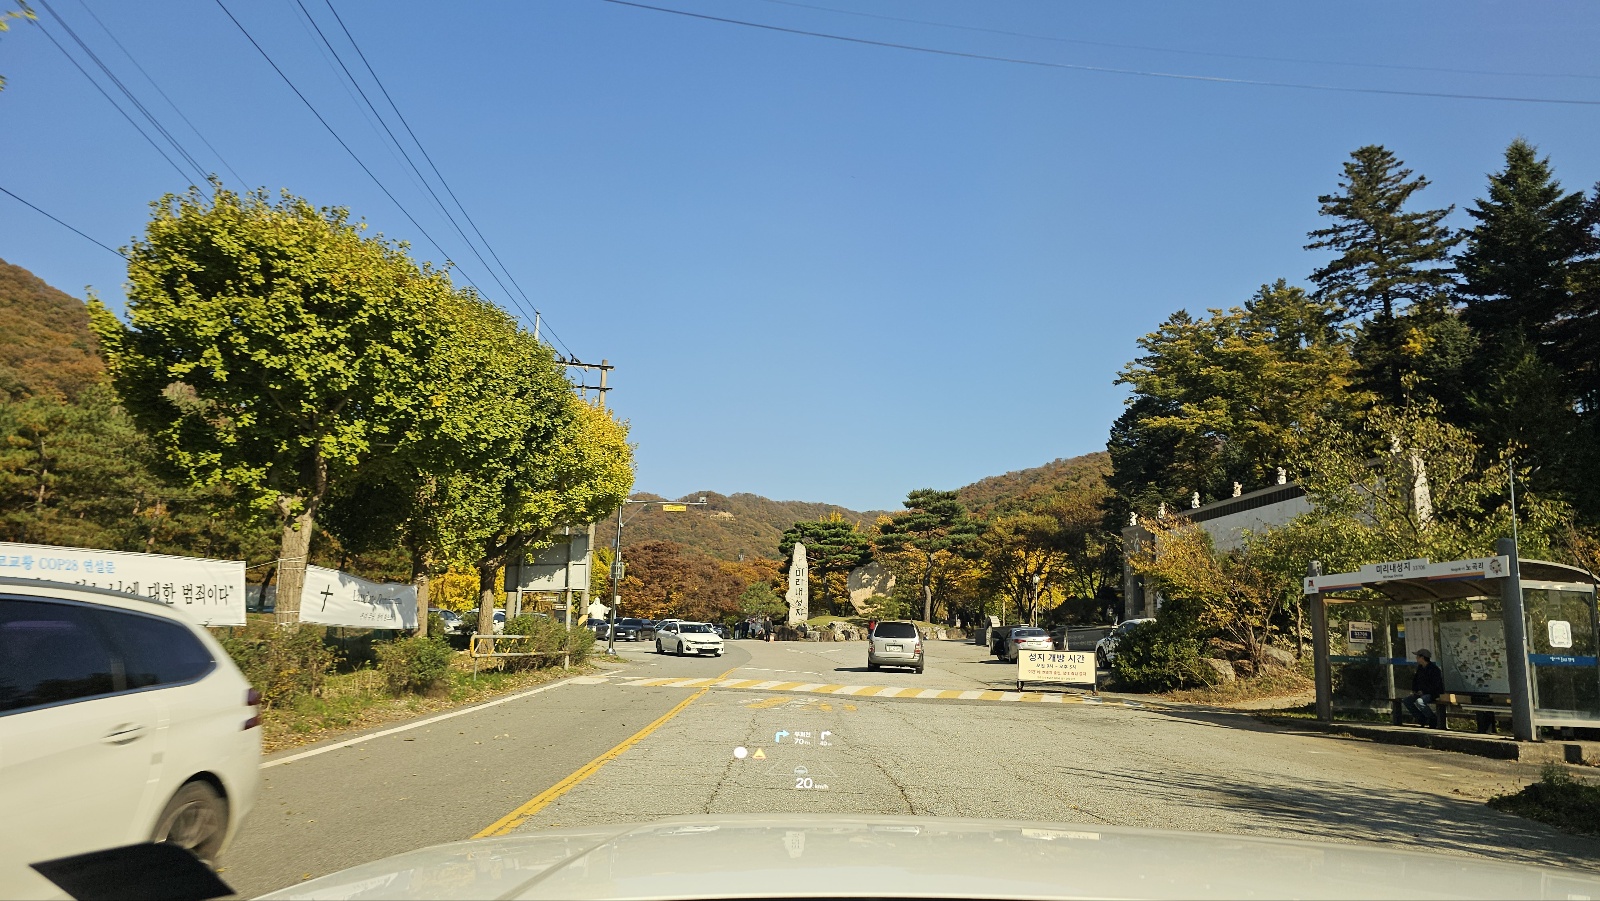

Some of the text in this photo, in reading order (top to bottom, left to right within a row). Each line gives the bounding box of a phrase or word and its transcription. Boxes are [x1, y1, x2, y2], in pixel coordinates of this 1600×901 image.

[39, 557, 79, 571] COP28
[83, 560, 116, 574] 연설문
[1375, 562, 1411, 575] 미리내성지
[1465, 562, 1484, 571] 노곡리
[795, 569, 804, 616] 미리내성지
[1028, 652, 1085, 664] 성지 개방 시간
[795, 777, 813, 789] 20
